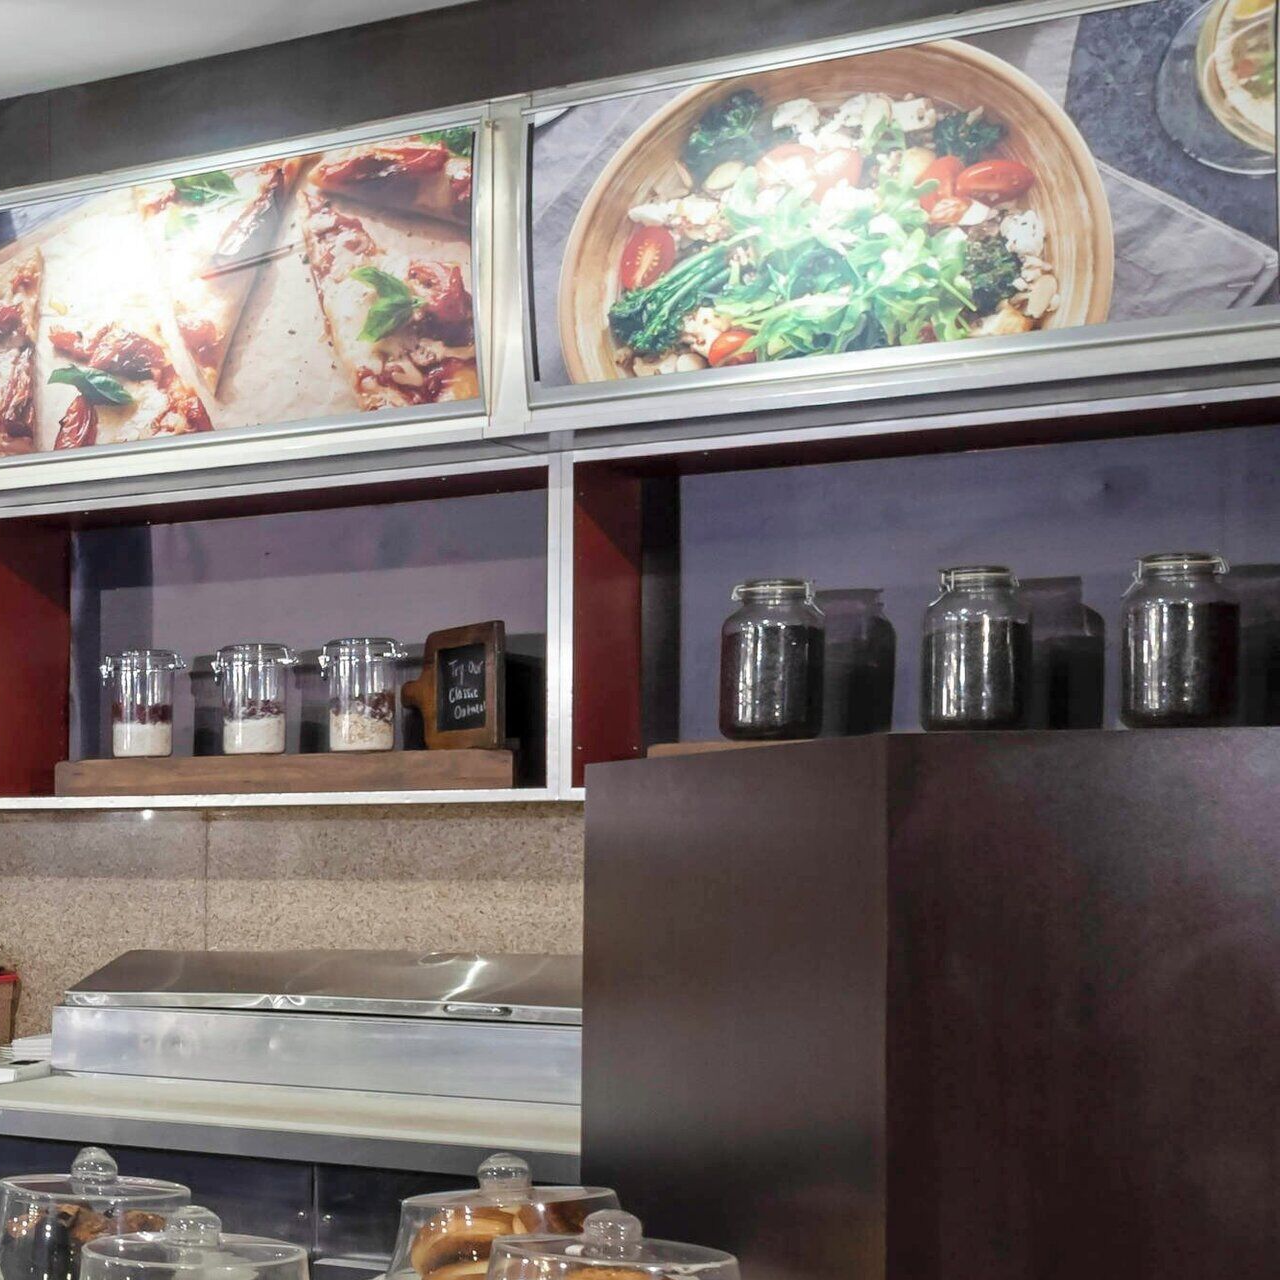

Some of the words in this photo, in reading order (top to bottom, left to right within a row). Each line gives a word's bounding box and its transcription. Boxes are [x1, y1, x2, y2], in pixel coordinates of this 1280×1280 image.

[448, 660, 464, 685] Try
[468, 660, 483, 675] Our
[448, 687, 479, 703] Classic
